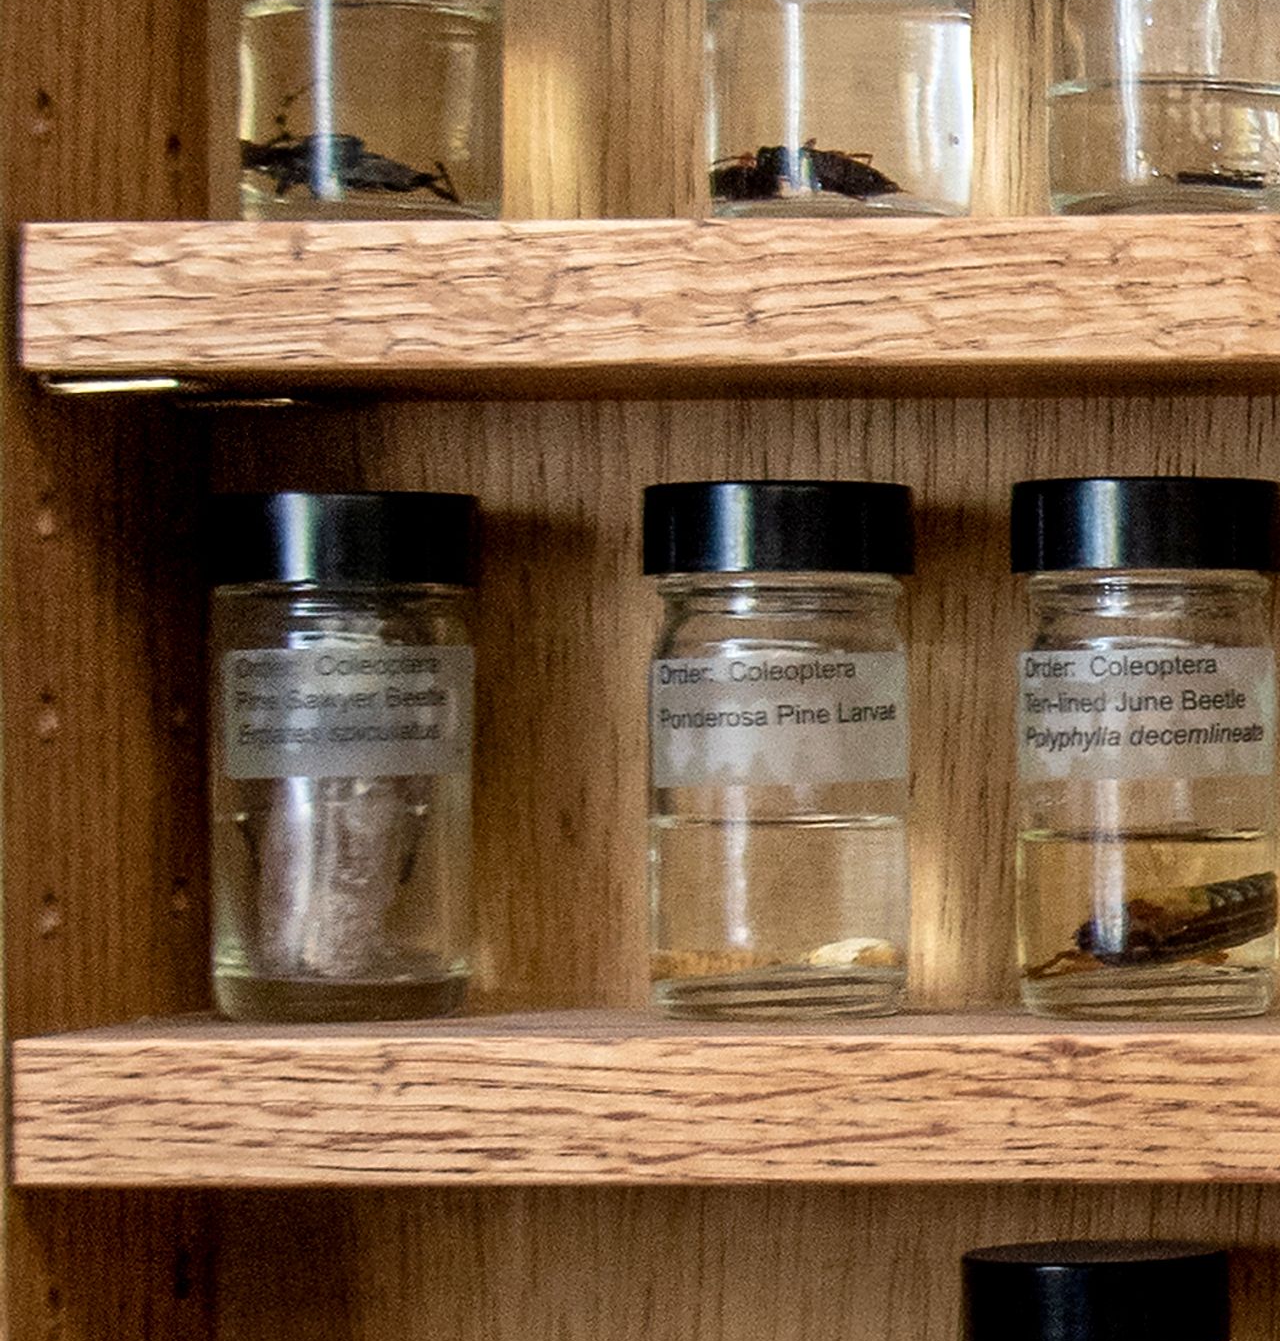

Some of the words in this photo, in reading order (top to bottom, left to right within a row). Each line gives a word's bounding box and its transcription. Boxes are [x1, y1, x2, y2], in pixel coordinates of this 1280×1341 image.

[728, 660, 857, 685] Coleoptera
[1025, 658, 1076, 679] Order:
[1090, 655, 1217, 680] Coleoptera
[1115, 691, 1174, 712] June
[1182, 688, 1247, 710] Beetle
[661, 707, 768, 730] Ponderosa
[776, 704, 832, 726] Pine
